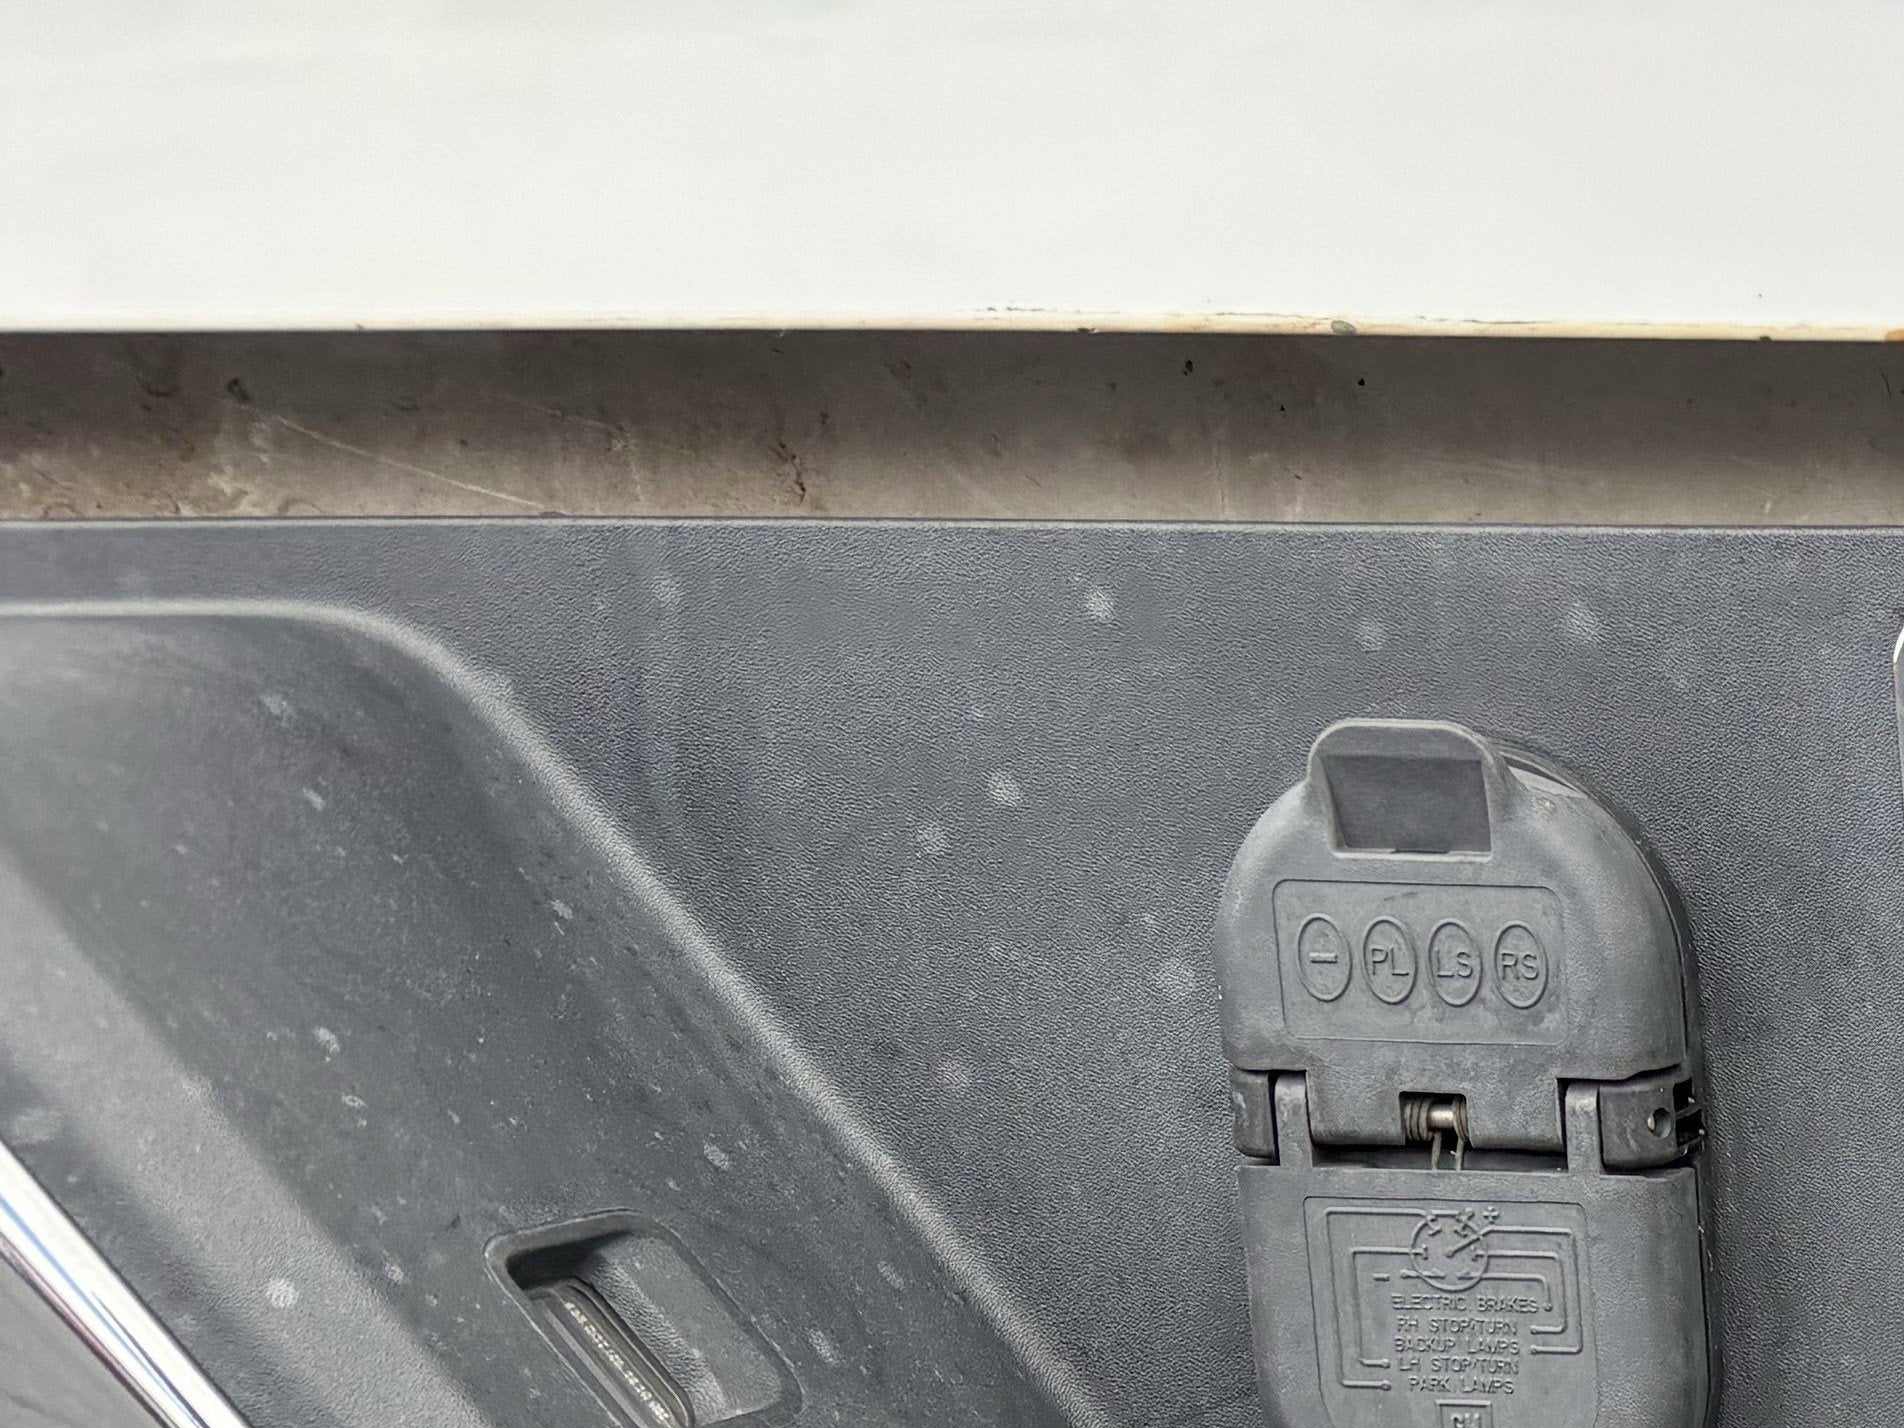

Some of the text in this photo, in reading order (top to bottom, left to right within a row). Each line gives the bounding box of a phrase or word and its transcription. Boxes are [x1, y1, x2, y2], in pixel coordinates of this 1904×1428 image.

[1370, 947, 1540, 980] PL LS RS
[1391, 1293, 1539, 1313] ELECTRIC BRAKES
[1397, 1315, 1518, 1336] RH STOP/TURN
[1394, 1335, 1520, 1355] BACKUP LAMPS
[1399, 1357, 1519, 1374] LH STOP/TURN
[1408, 1375, 1515, 1394] PARK LAMPS
